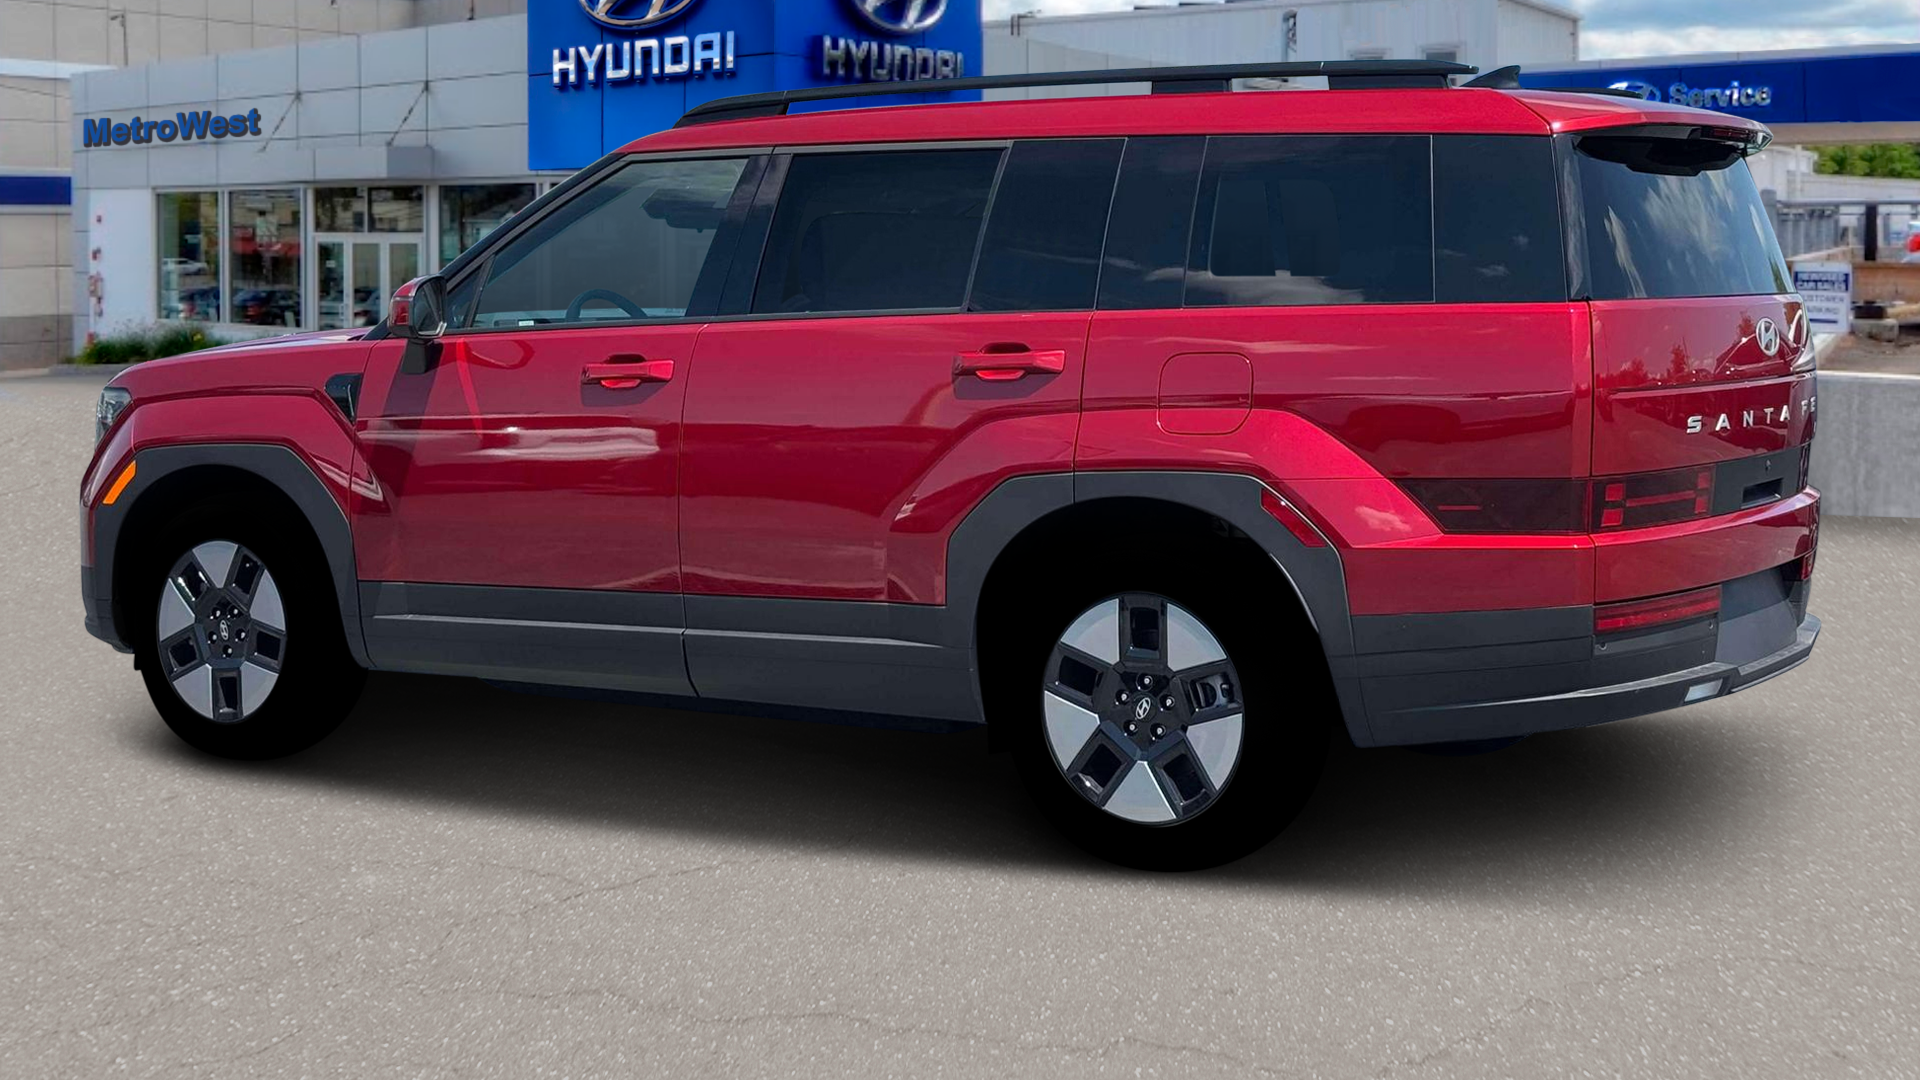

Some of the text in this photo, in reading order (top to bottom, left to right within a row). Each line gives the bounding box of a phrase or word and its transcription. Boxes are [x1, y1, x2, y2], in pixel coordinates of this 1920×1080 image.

[552, 30, 736, 85] HYUNDAI
[822, 34, 965, 81] HYUNDAI
[1669, 80, 1773, 107] Service
[83, 107, 262, 148] MetroWest
[1802, 294, 1845, 303] USTOMER
[1806, 305, 1839, 315] ARKING
[1686, 396, 1817, 434] SANTA FE
